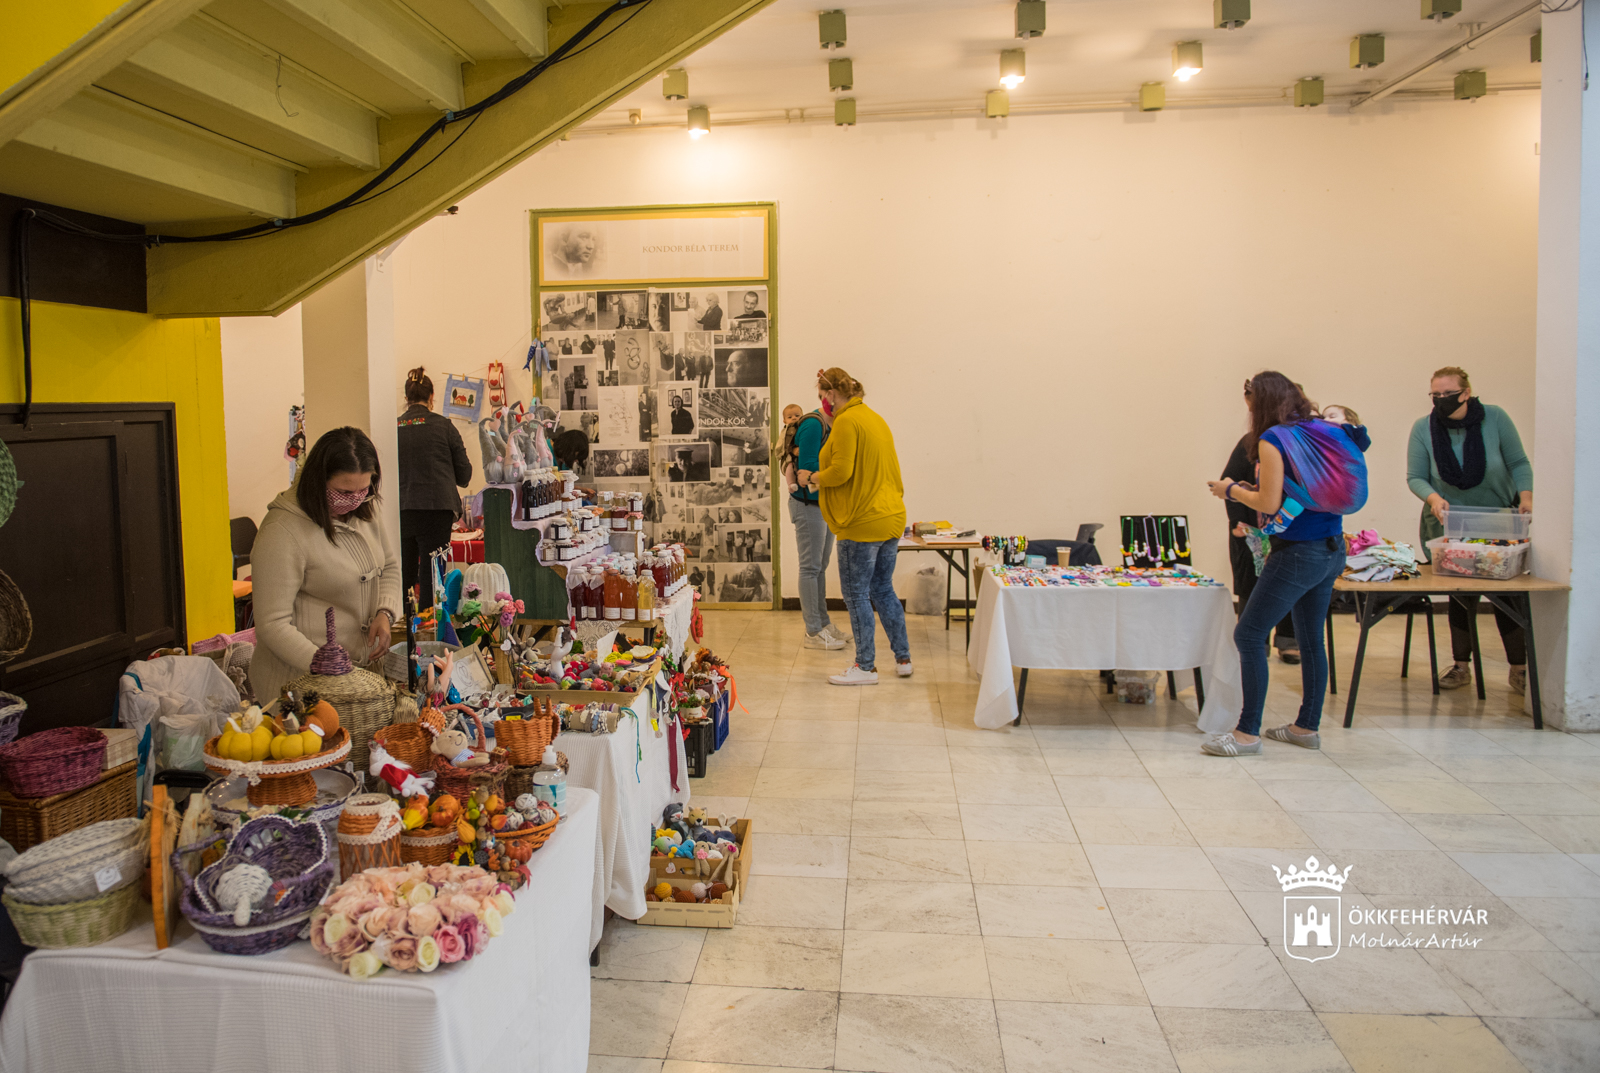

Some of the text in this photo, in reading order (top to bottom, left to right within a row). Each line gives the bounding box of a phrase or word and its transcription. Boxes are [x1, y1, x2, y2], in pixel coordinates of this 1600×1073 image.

[642, 243, 739, 253] KONDOR BÉLA TEREM
[698, 416, 746, 425] NDOR KÖR
